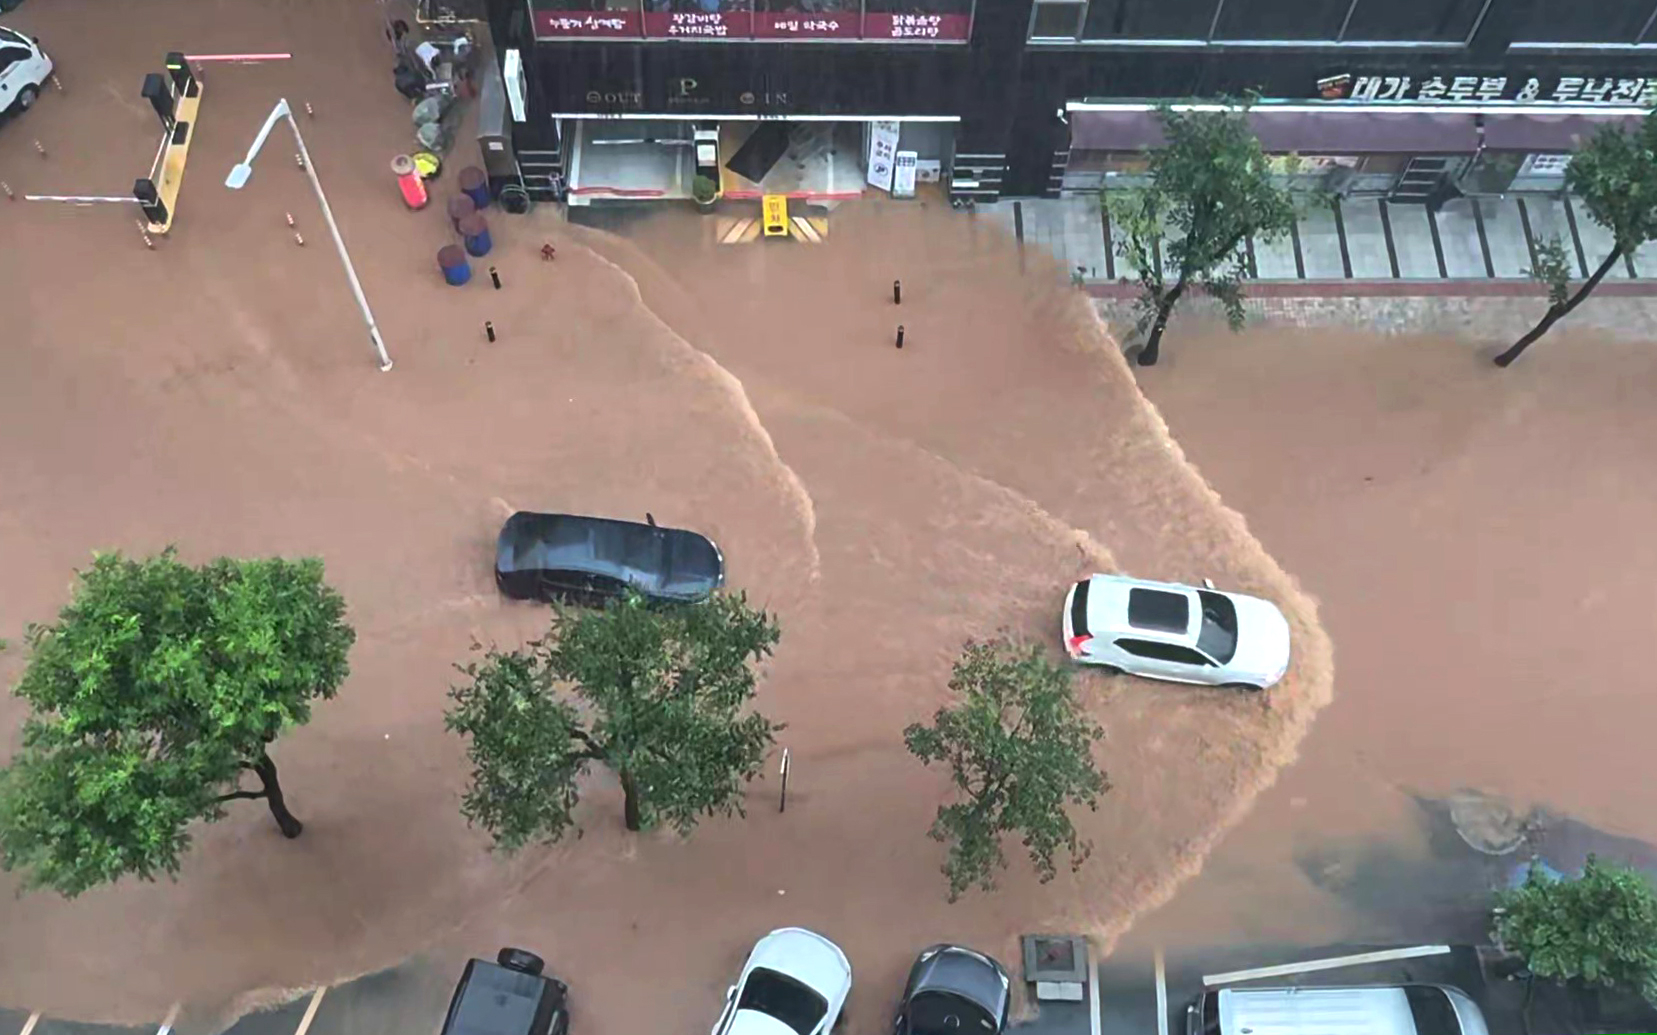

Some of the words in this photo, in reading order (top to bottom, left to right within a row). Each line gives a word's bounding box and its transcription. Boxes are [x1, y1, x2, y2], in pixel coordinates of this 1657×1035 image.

[1351, 76, 1411, 101] 대가
[1418, 76, 1507, 101] 순두부
[1516, 78, 1540, 101] &
